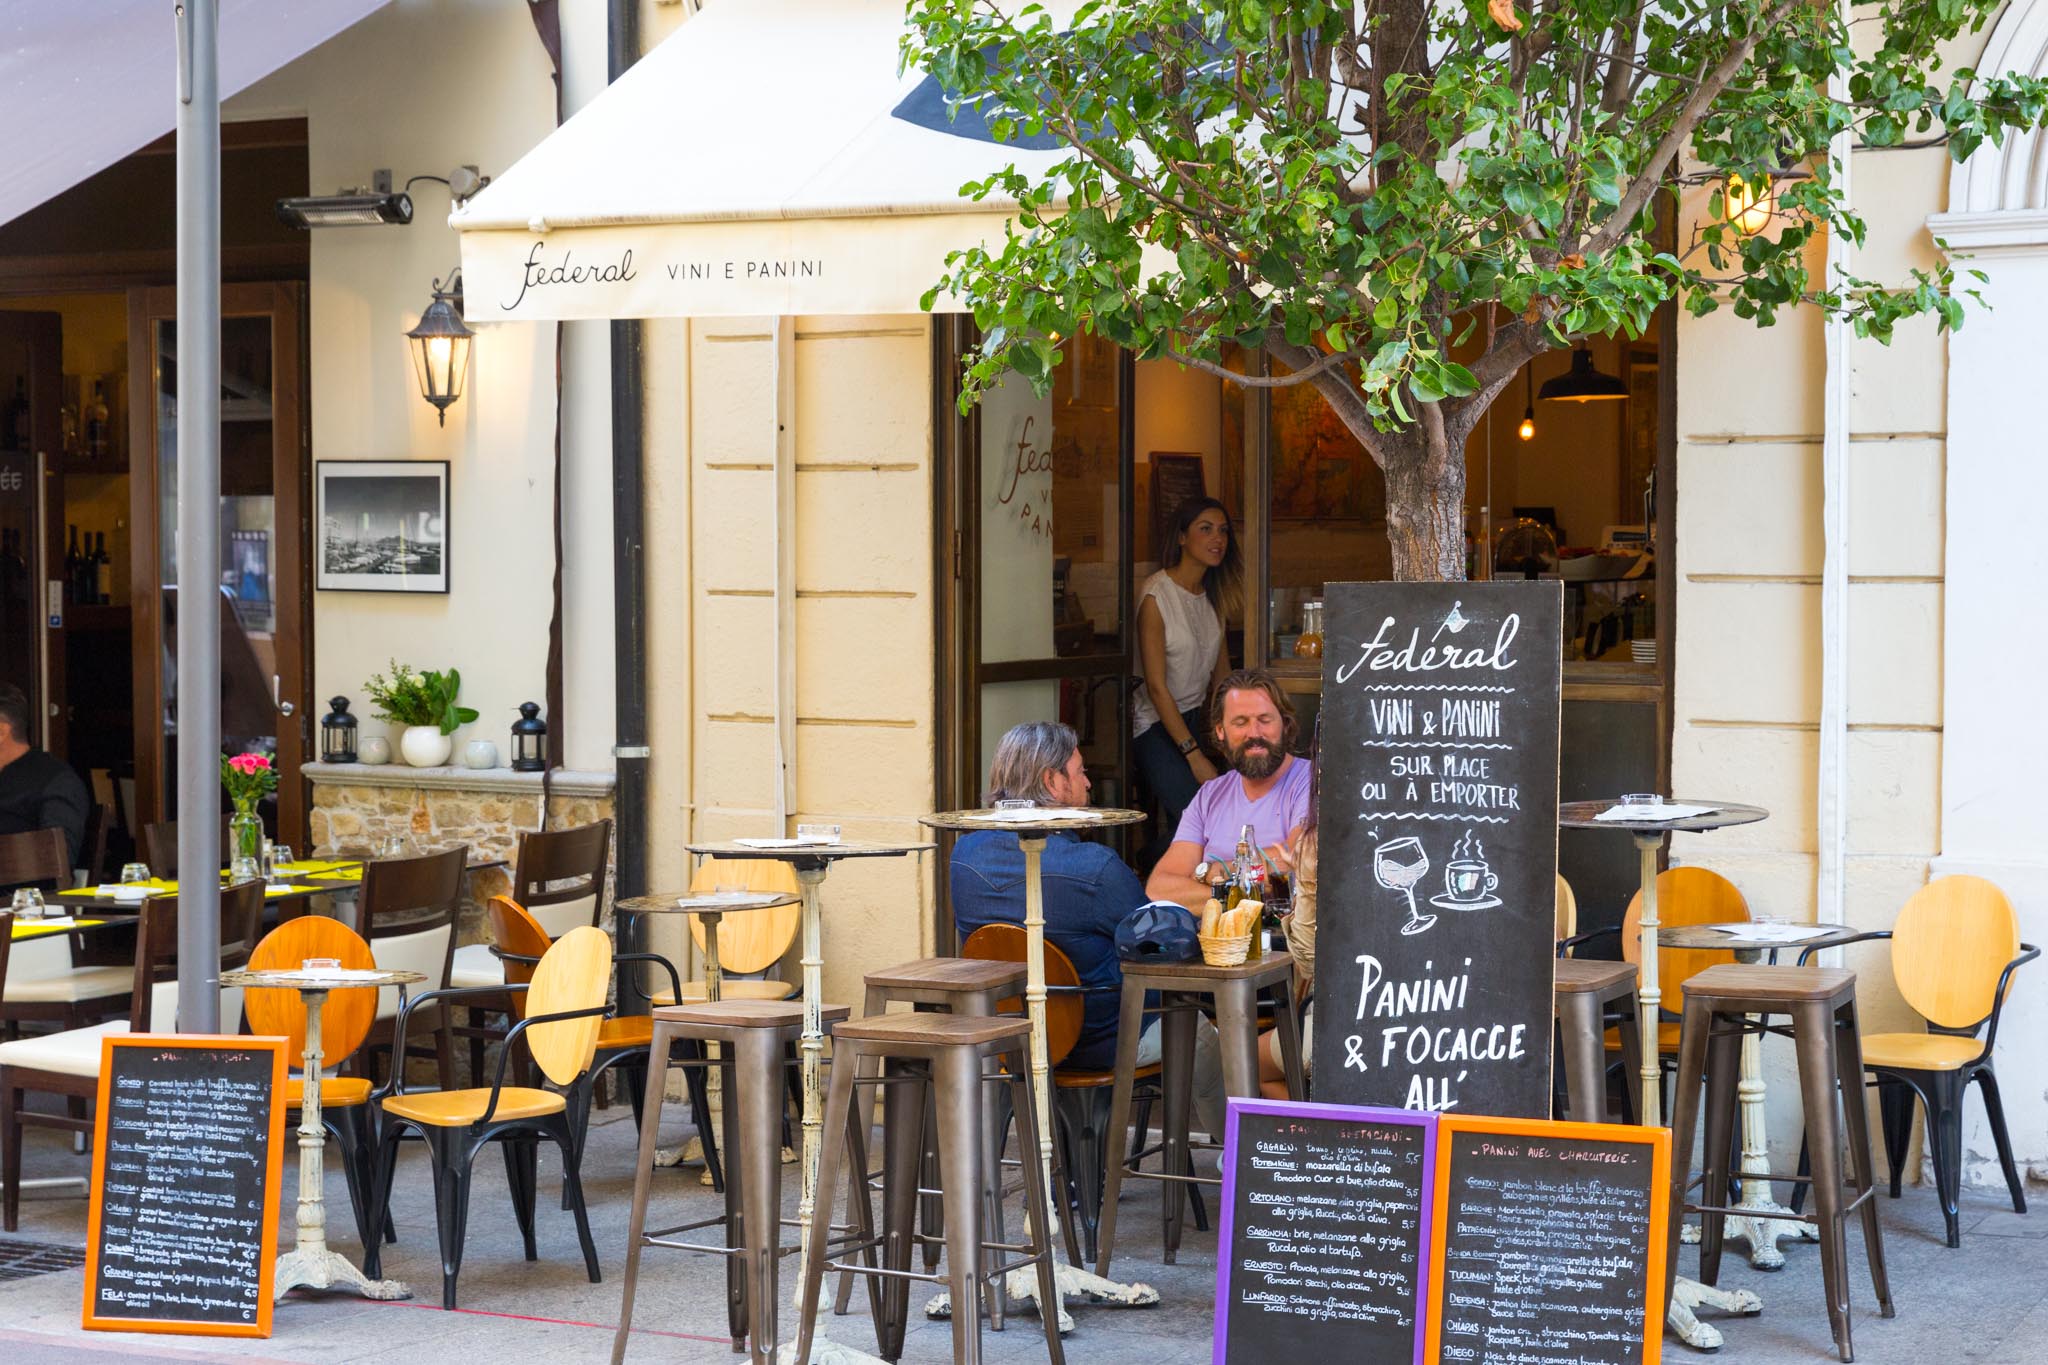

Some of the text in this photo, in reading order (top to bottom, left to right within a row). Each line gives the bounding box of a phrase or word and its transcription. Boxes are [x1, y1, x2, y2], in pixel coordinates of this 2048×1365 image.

[667, 264, 710, 280] VINI
[725, 262, 734, 279] E
[747, 260, 822, 279] PANINI
[1423, 711, 1437, 735] &
[1391, 755, 1490, 779] SUR PLACE
[1406, 778, 1418, 800] À
[1431, 782, 1520, 810] EMPORTER
[1344, 1024, 1526, 1072] & FOCACCE
[1528, 1147, 1551, 1158] AVEC
[1306, 1161, 1351, 1172] mozzarella
[1353, 1162, 1363, 1172] di
[1364, 1161, 1391, 1175] bufala
[1273, 1171, 1312, 1183] Pomodoro
[1335, 1175, 1344, 1184] di
[1406, 1188, 1419, 1197] 5,5
[1272, 1208, 1287, 1217] alla
[1358, 1212, 1366, 1221] di
[1300, 1244, 1316, 1254] olio
[1319, 1244, 1328, 1255] al
[1313, 1231, 1358, 1243] melanzane
[1360, 1233, 1376, 1245] alla
[1378, 1234, 1407, 1251] griglia
[1321, 1265, 1361, 1277] melanzane
[1363, 1268, 1378, 1279] alla
[1294, 1305, 1309, 1315] alla
